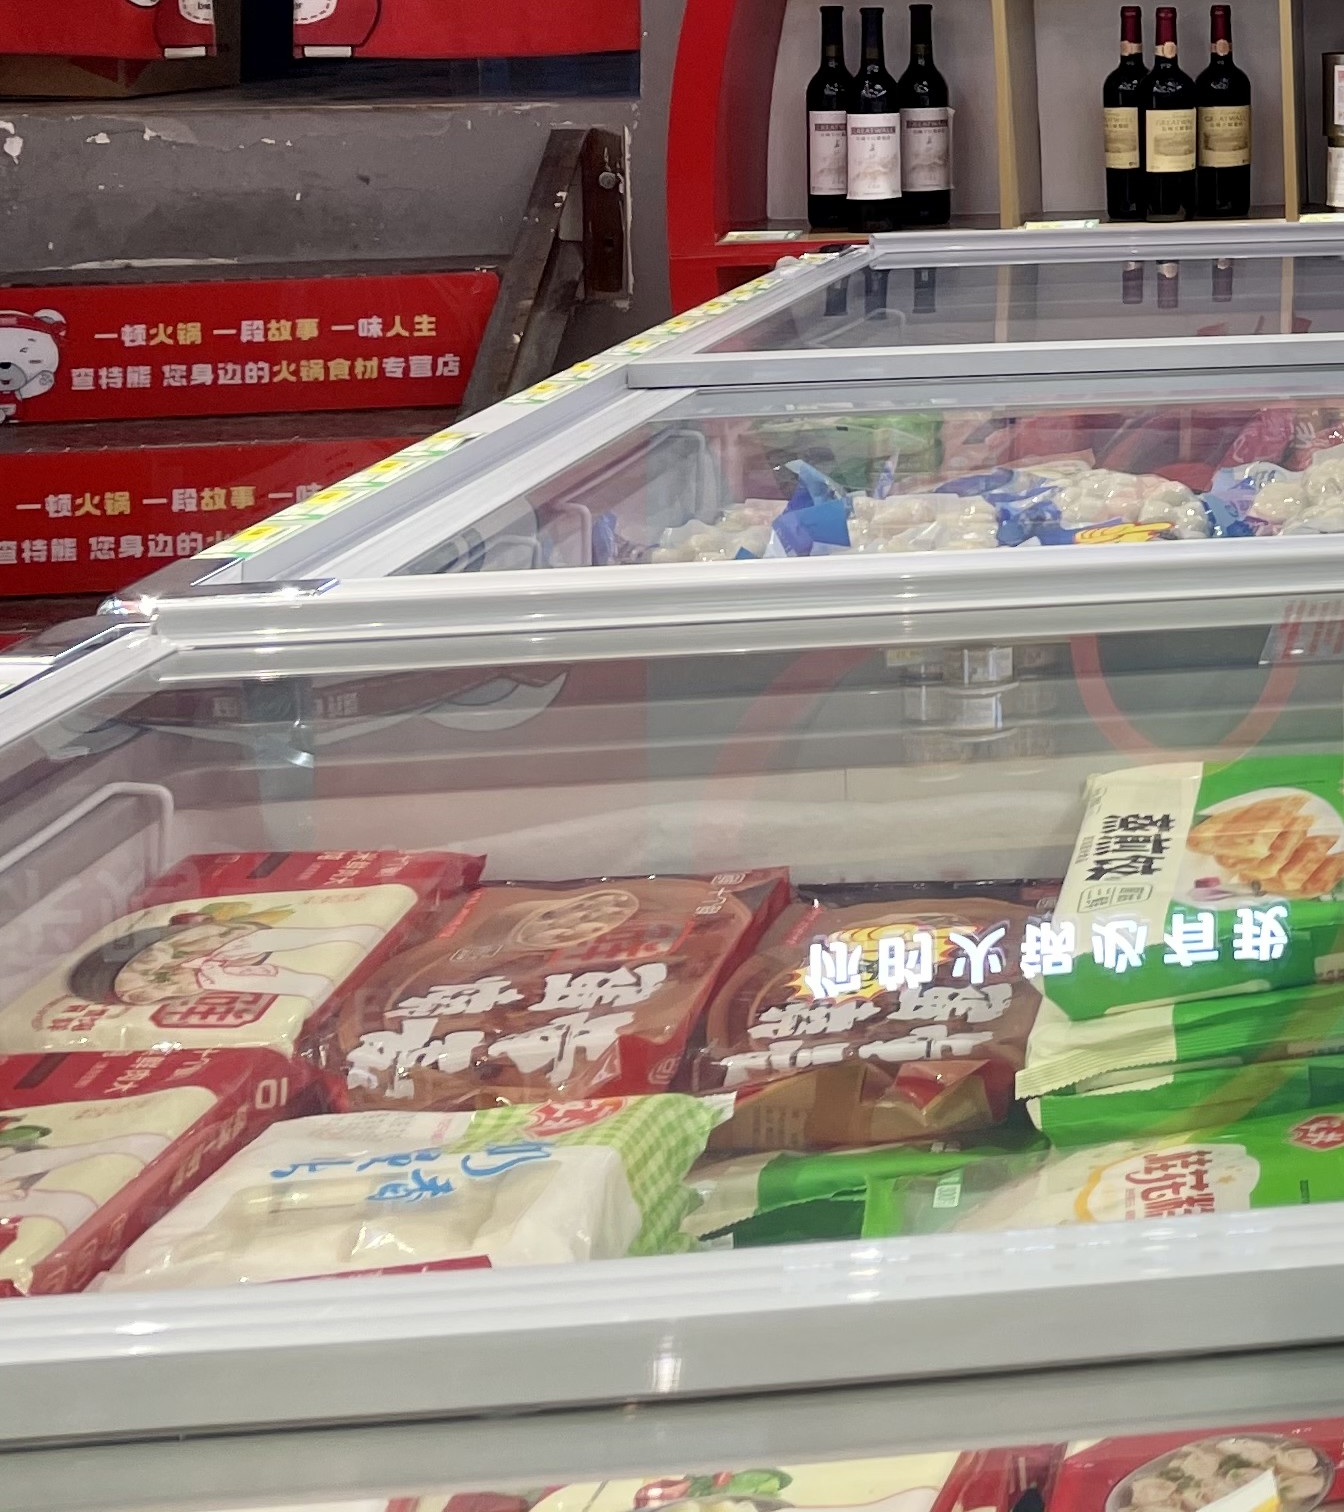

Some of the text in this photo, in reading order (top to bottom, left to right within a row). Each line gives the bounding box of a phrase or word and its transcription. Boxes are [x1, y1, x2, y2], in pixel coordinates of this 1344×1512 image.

[95, 314, 438, 346] 一顿火锅 一段故事 一味人生
[71, 354, 460, 391] 查特熊 您身边的火锅食材专营店
[16, 492, 131, 518] 一顿火锅
[143, 486, 256, 513] 一段故事
